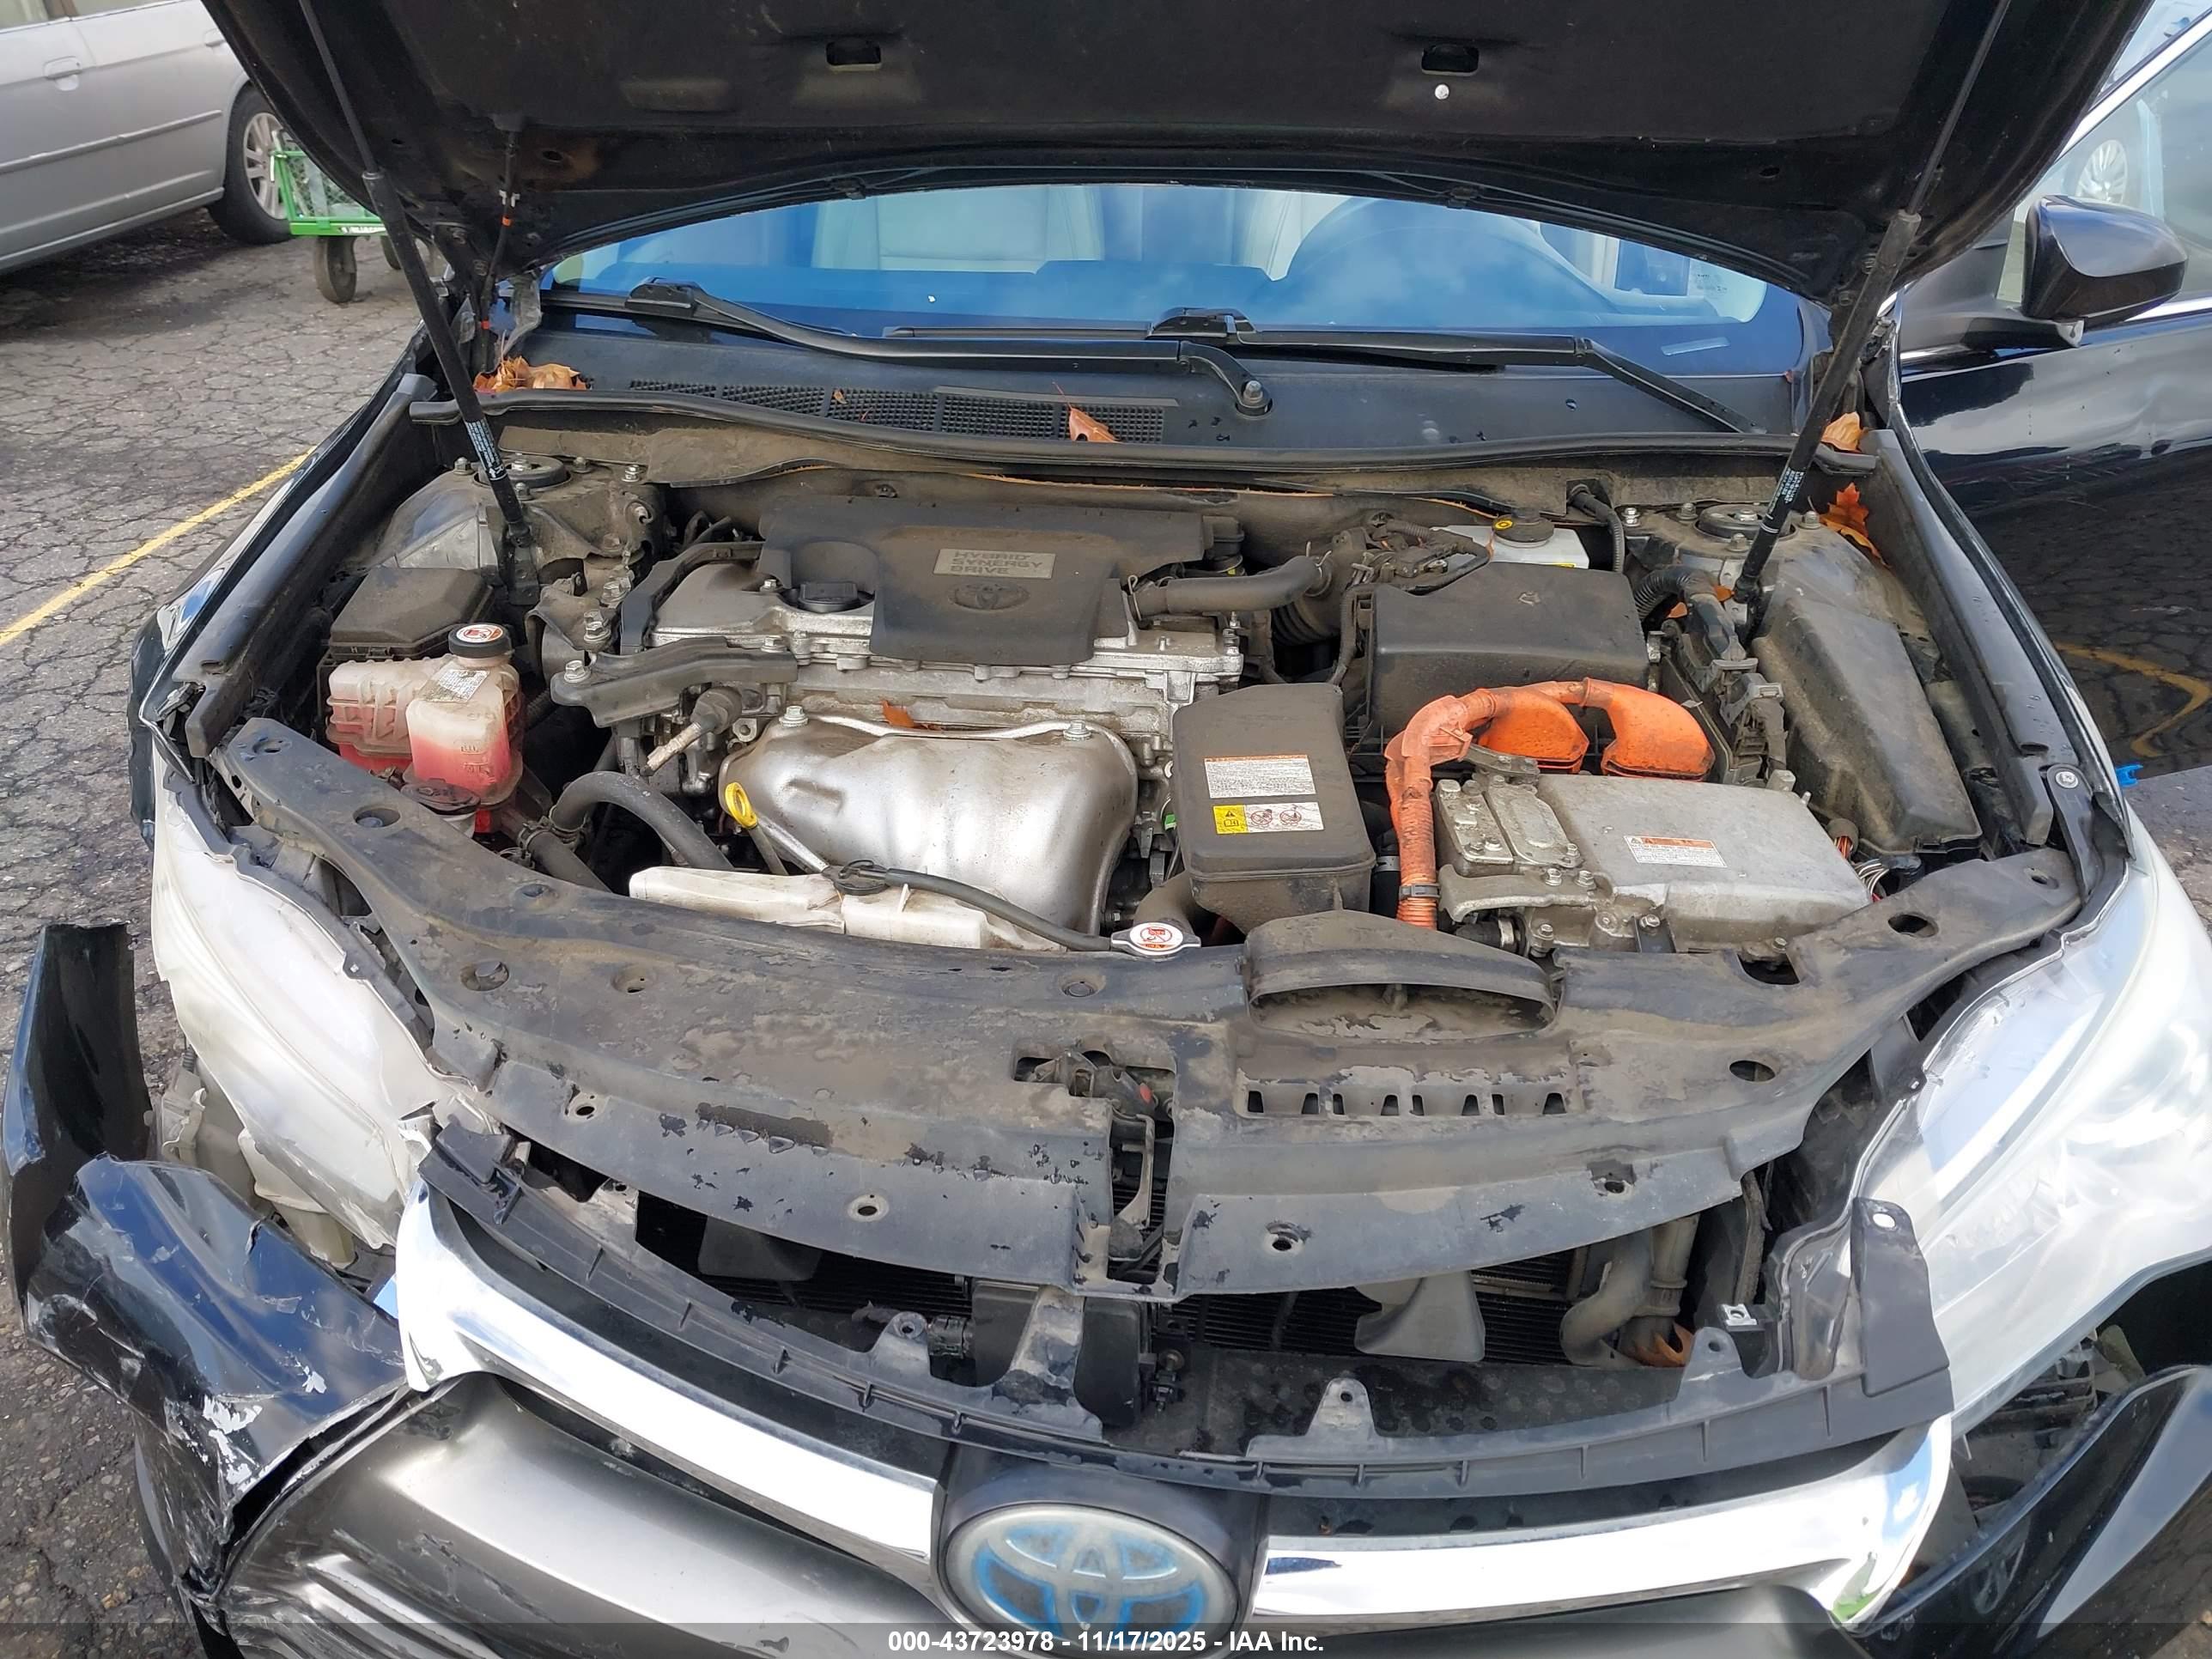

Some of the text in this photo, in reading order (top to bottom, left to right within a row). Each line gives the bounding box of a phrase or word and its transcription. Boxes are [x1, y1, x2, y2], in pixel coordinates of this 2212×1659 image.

[954, 550, 1030, 560] HYBRID
[952, 557, 1042, 568] SYNERGY
[951, 565, 1010, 574] DRIVE
